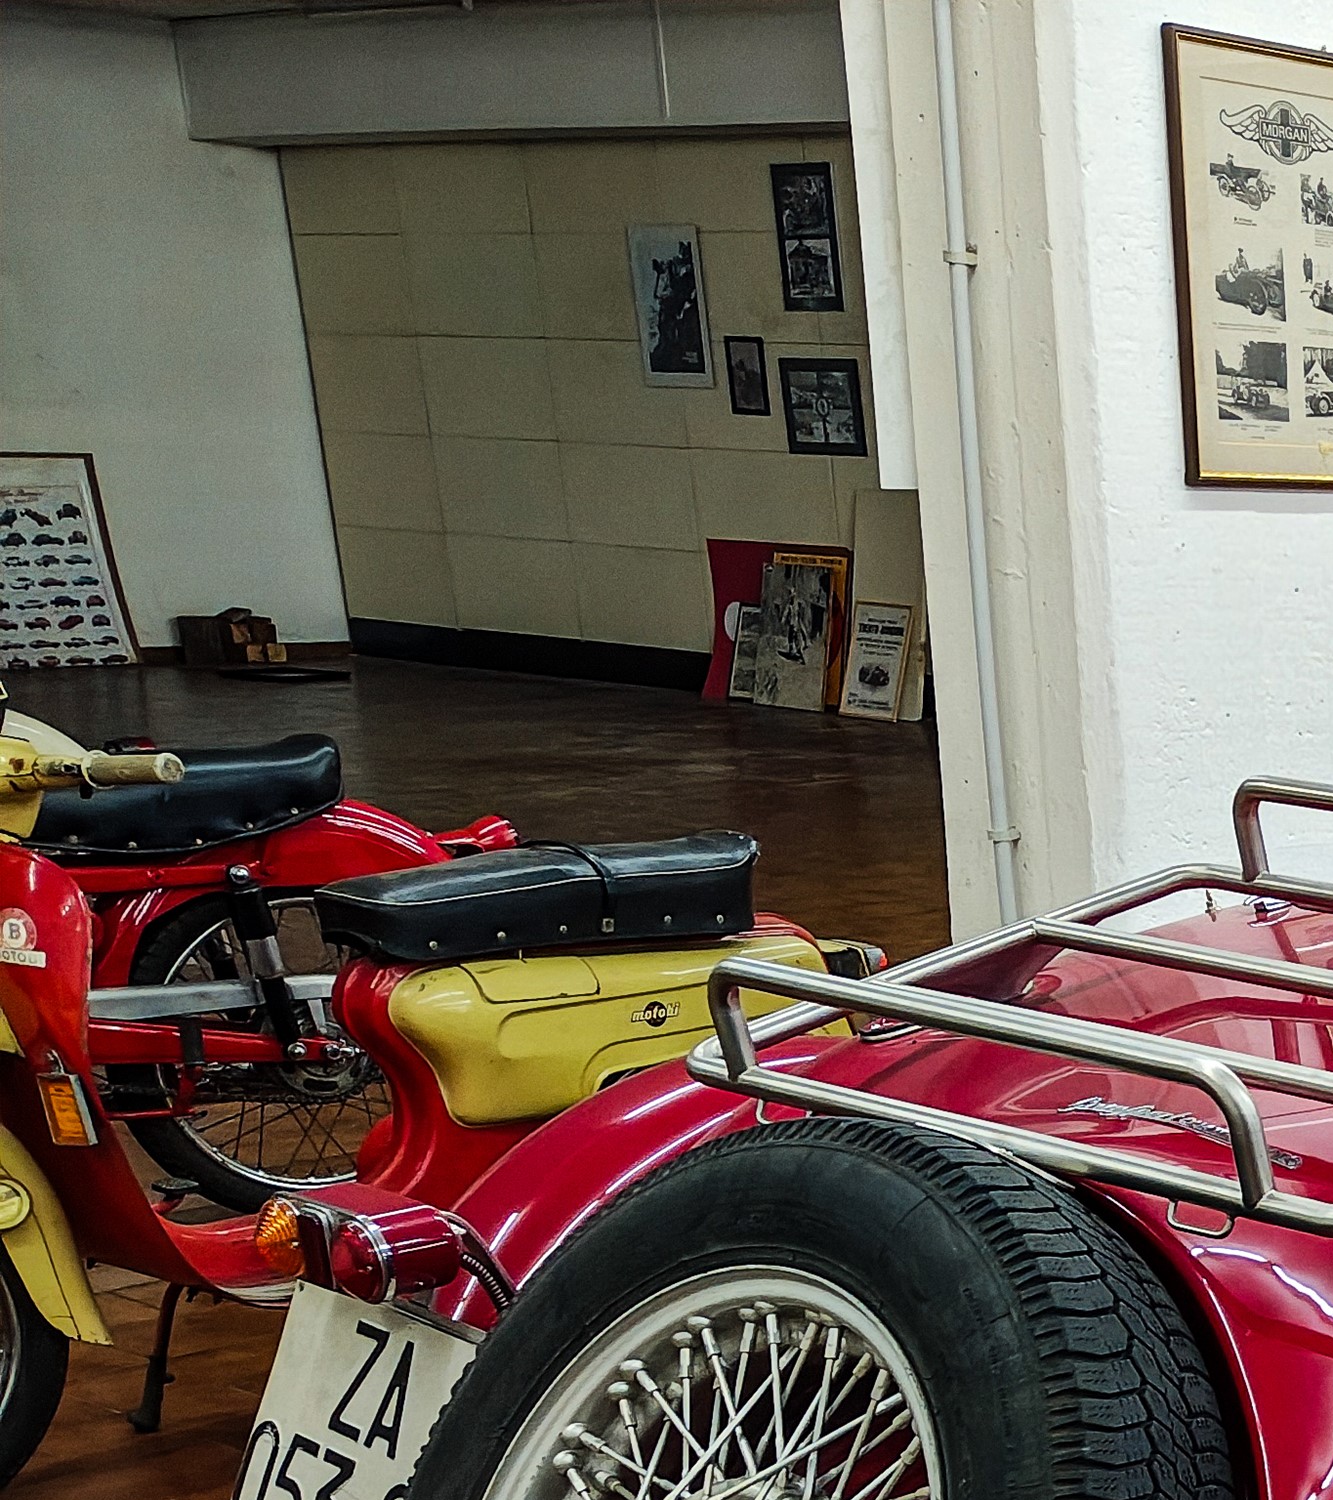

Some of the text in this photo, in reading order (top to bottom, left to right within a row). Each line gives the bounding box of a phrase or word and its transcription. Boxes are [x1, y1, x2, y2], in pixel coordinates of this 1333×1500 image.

[1262, 122, 1309, 143] MORGAN
[631, 1002, 681, 1023] motobi
[328, 1319, 415, 1461] ZA
